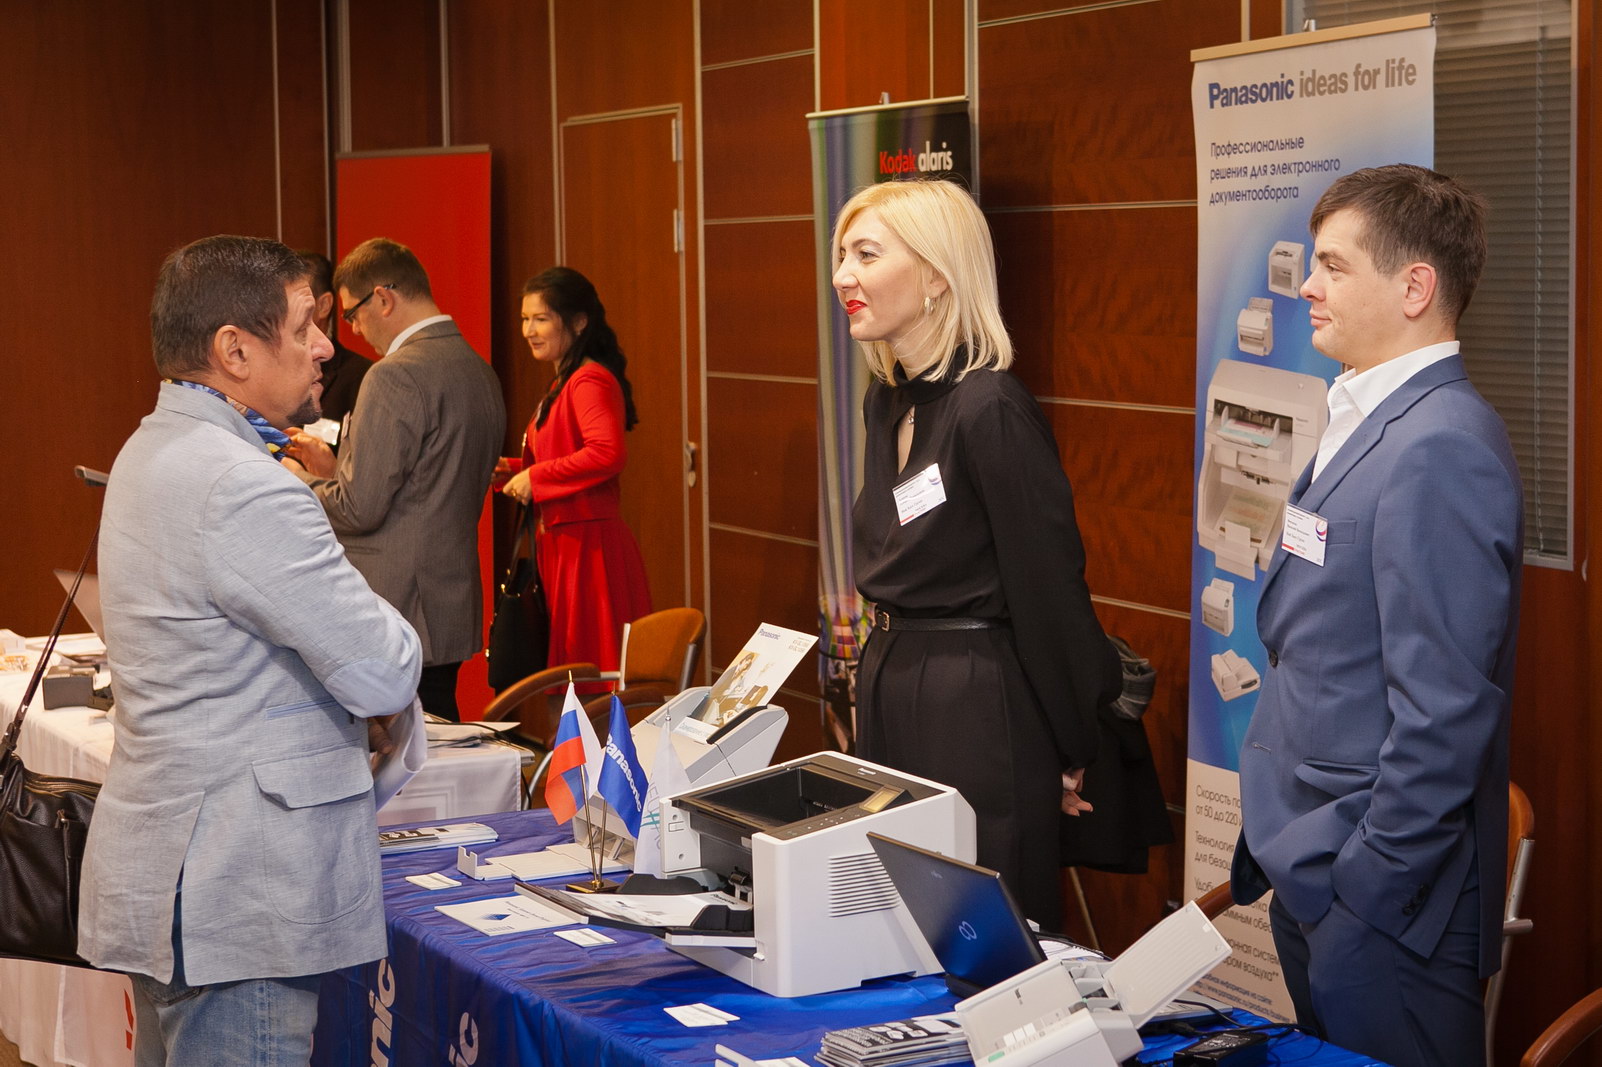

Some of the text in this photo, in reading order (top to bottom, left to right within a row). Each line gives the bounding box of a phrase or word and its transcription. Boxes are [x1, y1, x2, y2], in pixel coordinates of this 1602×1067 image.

[1208, 57, 1417, 109] Panasonic ideas for life
[879, 141, 953, 174] Kodak alaris
[1210, 136, 1305, 159] Профессиональные
[1210, 158, 1341, 184] решения для электронного
[1209, 184, 1299, 207] документооборота
[1195, 784, 1231, 806] Скорость
[1195, 804, 1238, 826] от 50 до 220
[1194, 851, 1208, 863] для
